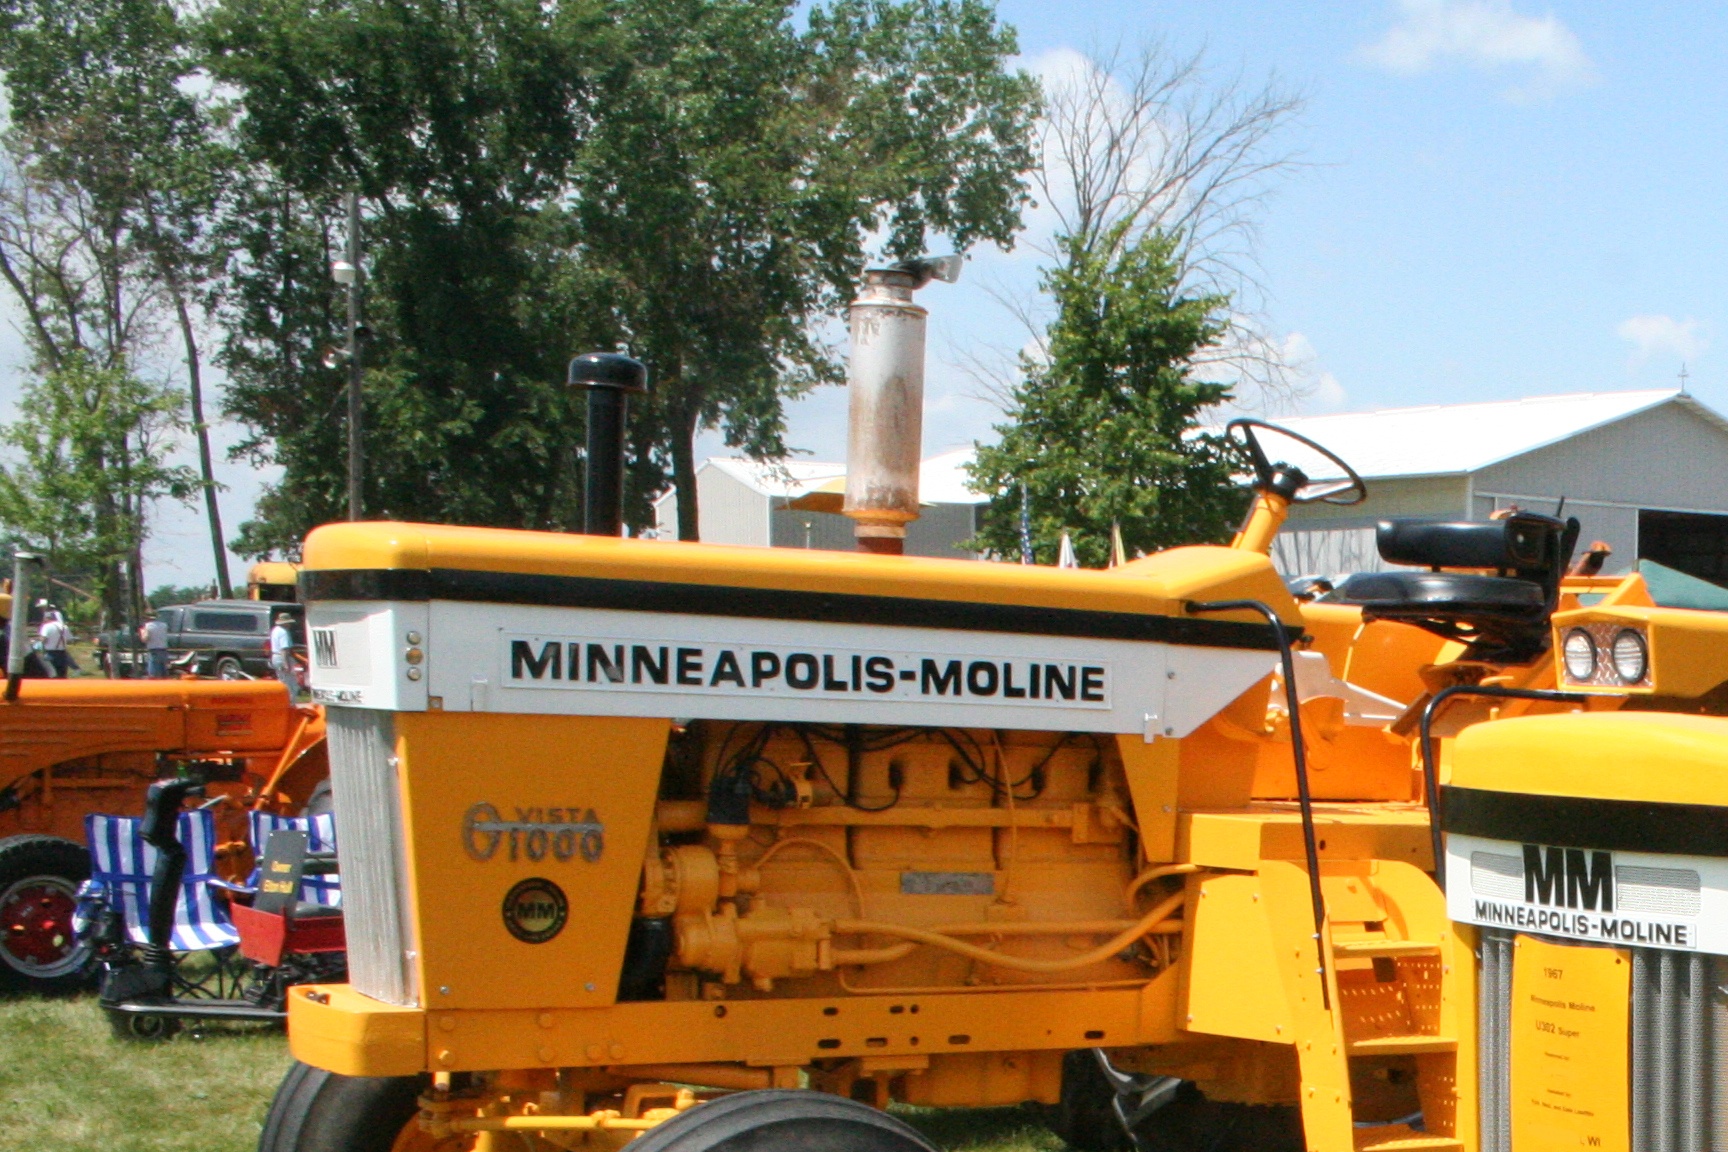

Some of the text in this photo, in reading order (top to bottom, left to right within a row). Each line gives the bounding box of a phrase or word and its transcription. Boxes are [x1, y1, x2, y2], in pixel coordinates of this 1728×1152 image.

[510, 639, 1106, 701] MINNEAPOLIS-MOLINE
[1521, 843, 1614, 914] MM
[1474, 898, 1689, 946] MINNEAPOLIS-MOLINE
